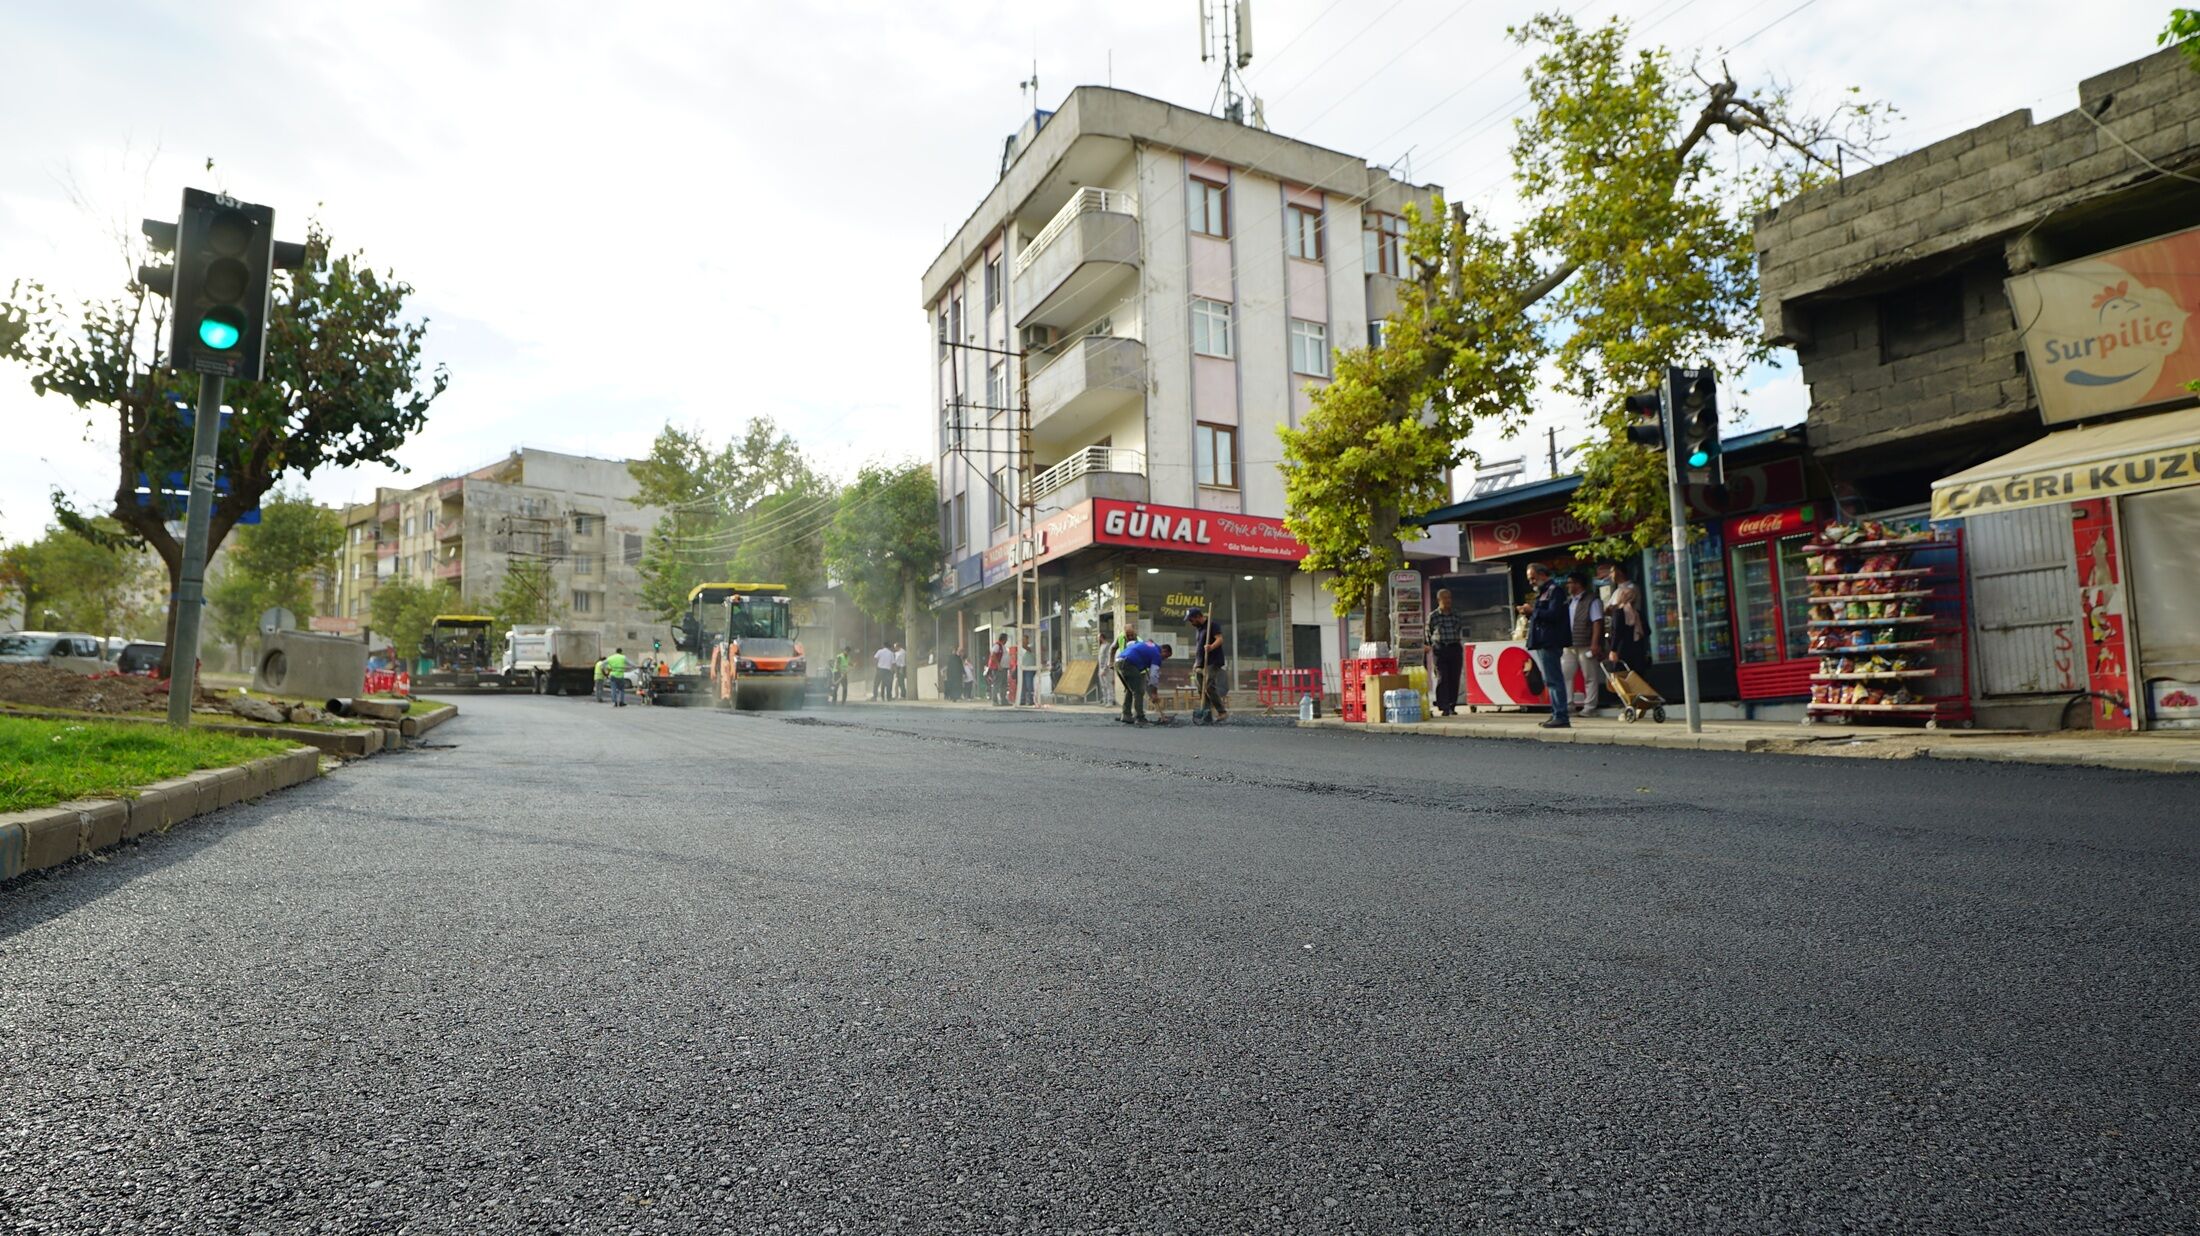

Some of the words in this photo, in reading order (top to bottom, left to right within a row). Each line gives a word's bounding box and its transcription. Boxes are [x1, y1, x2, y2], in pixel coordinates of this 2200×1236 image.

[2045, 316, 2173, 364] Surpiliç
[1949, 472, 2073, 514] ÇAĞRI
[1105, 505, 1211, 544] GÜNAL
[1738, 513, 1784, 537] Coca-Cola
[1166, 592, 1206, 607] GÜNAL
